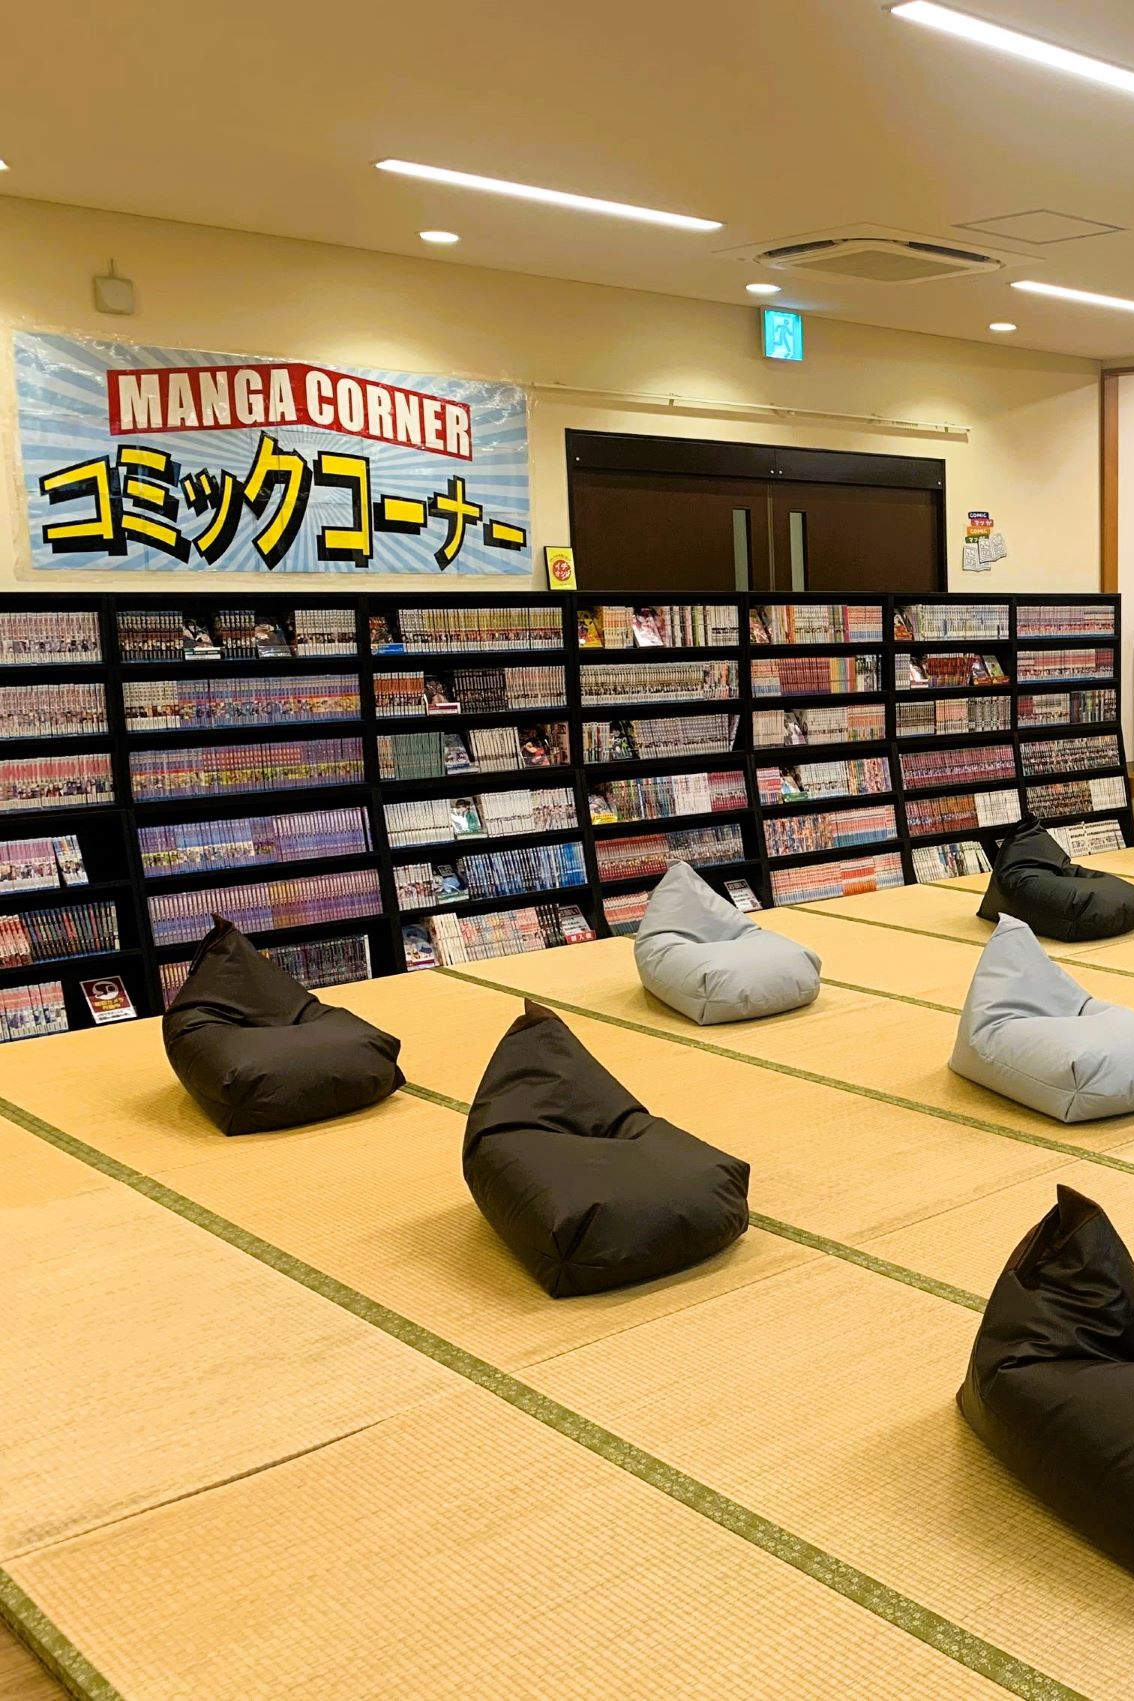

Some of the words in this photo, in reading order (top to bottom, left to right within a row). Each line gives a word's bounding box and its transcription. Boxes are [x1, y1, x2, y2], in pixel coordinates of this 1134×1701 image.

[118, 368, 298, 431] MANGA
[305, 371, 471, 457] CORNER
[40, 431, 527, 570] コミックコーナー
